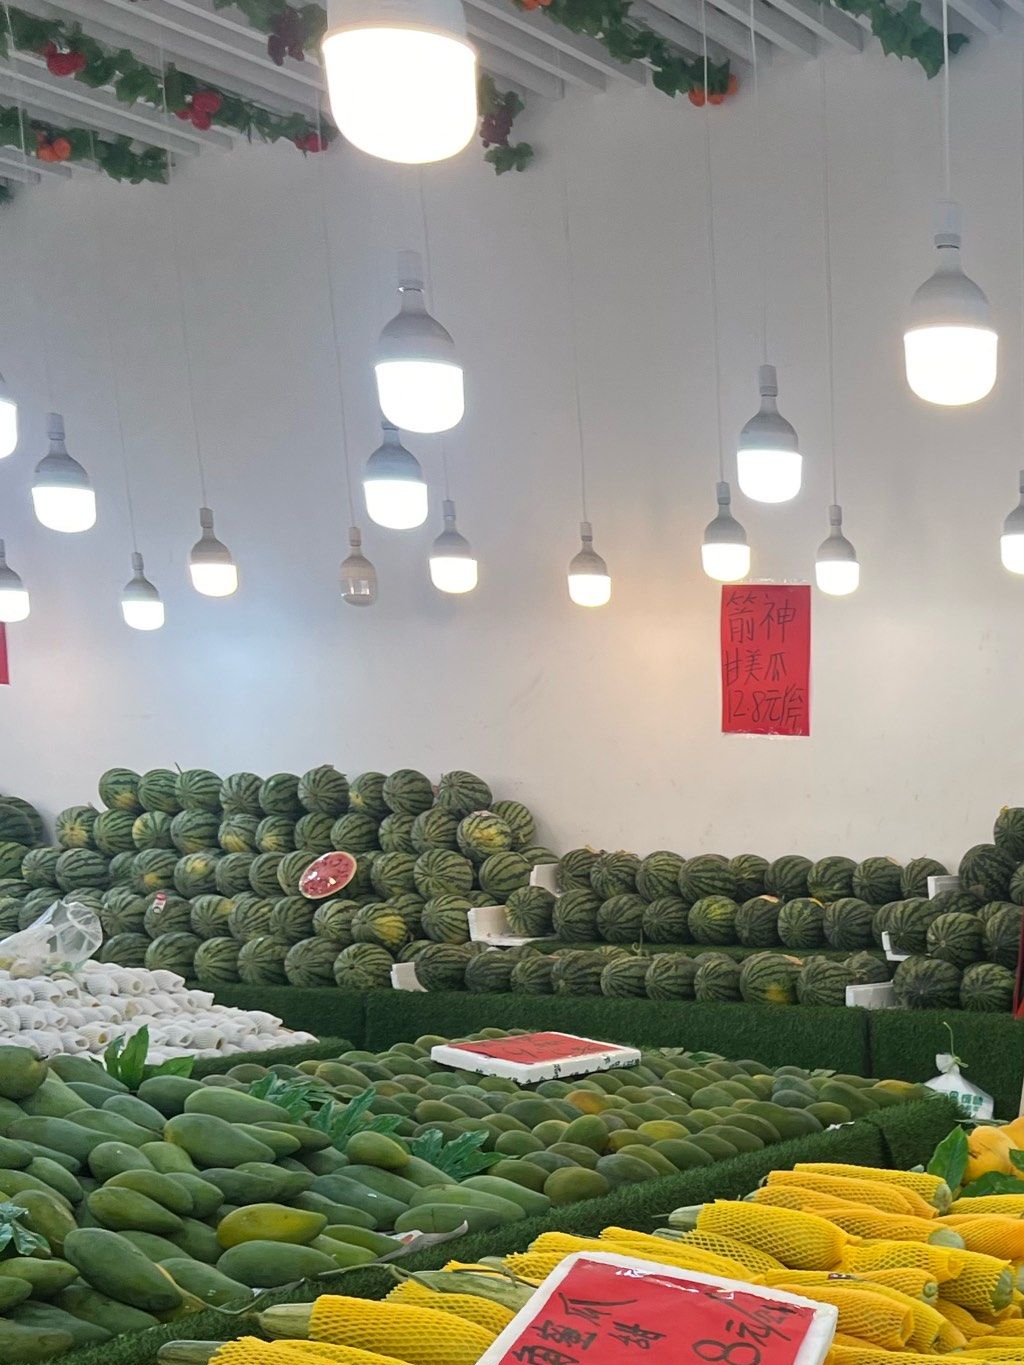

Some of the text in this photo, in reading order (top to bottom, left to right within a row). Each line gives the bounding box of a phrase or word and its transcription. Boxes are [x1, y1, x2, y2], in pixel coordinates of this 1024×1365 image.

[727, 591, 797, 643] 箭神
[724, 649, 787, 687] 甘美瓜
